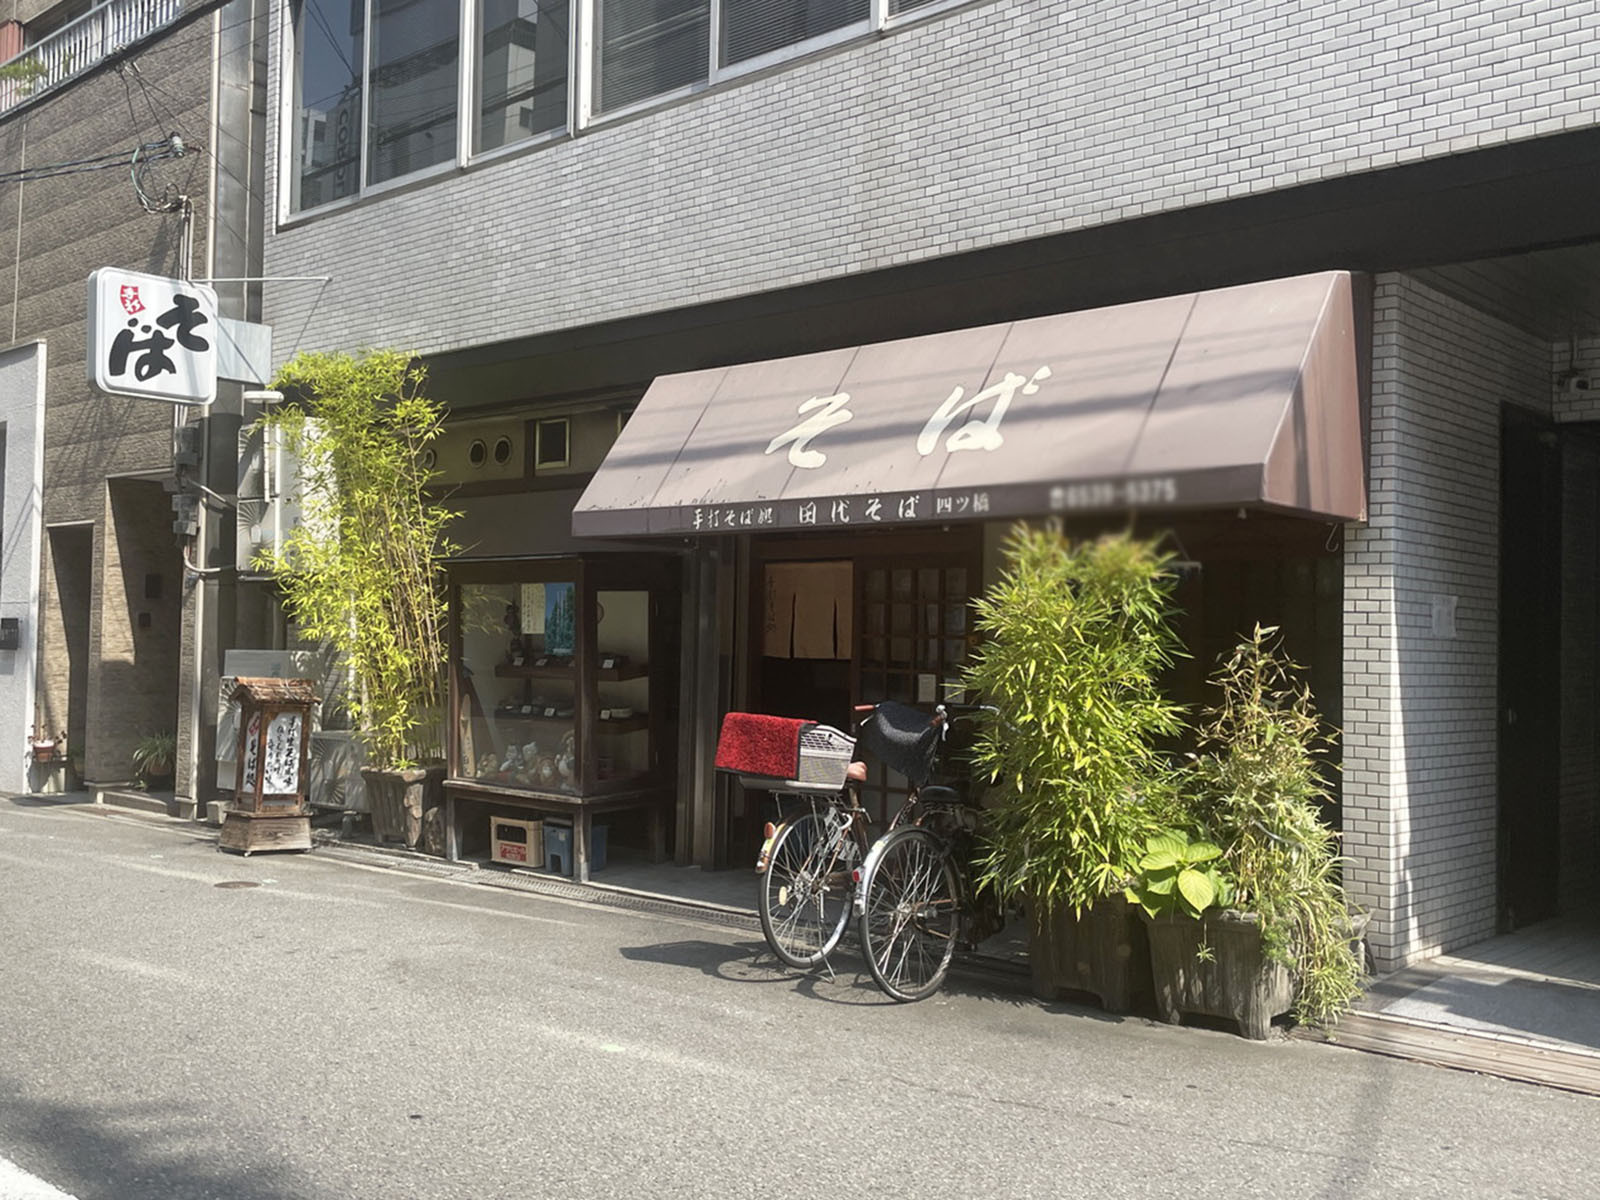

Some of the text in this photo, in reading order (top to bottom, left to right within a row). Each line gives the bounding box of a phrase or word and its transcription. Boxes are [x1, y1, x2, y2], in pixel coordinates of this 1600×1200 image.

[108, 293, 210, 383] そば
[765, 365, 1053, 468] そば
[692, 492, 991, 530] 手打そば処 田代そば 四ツ橋
